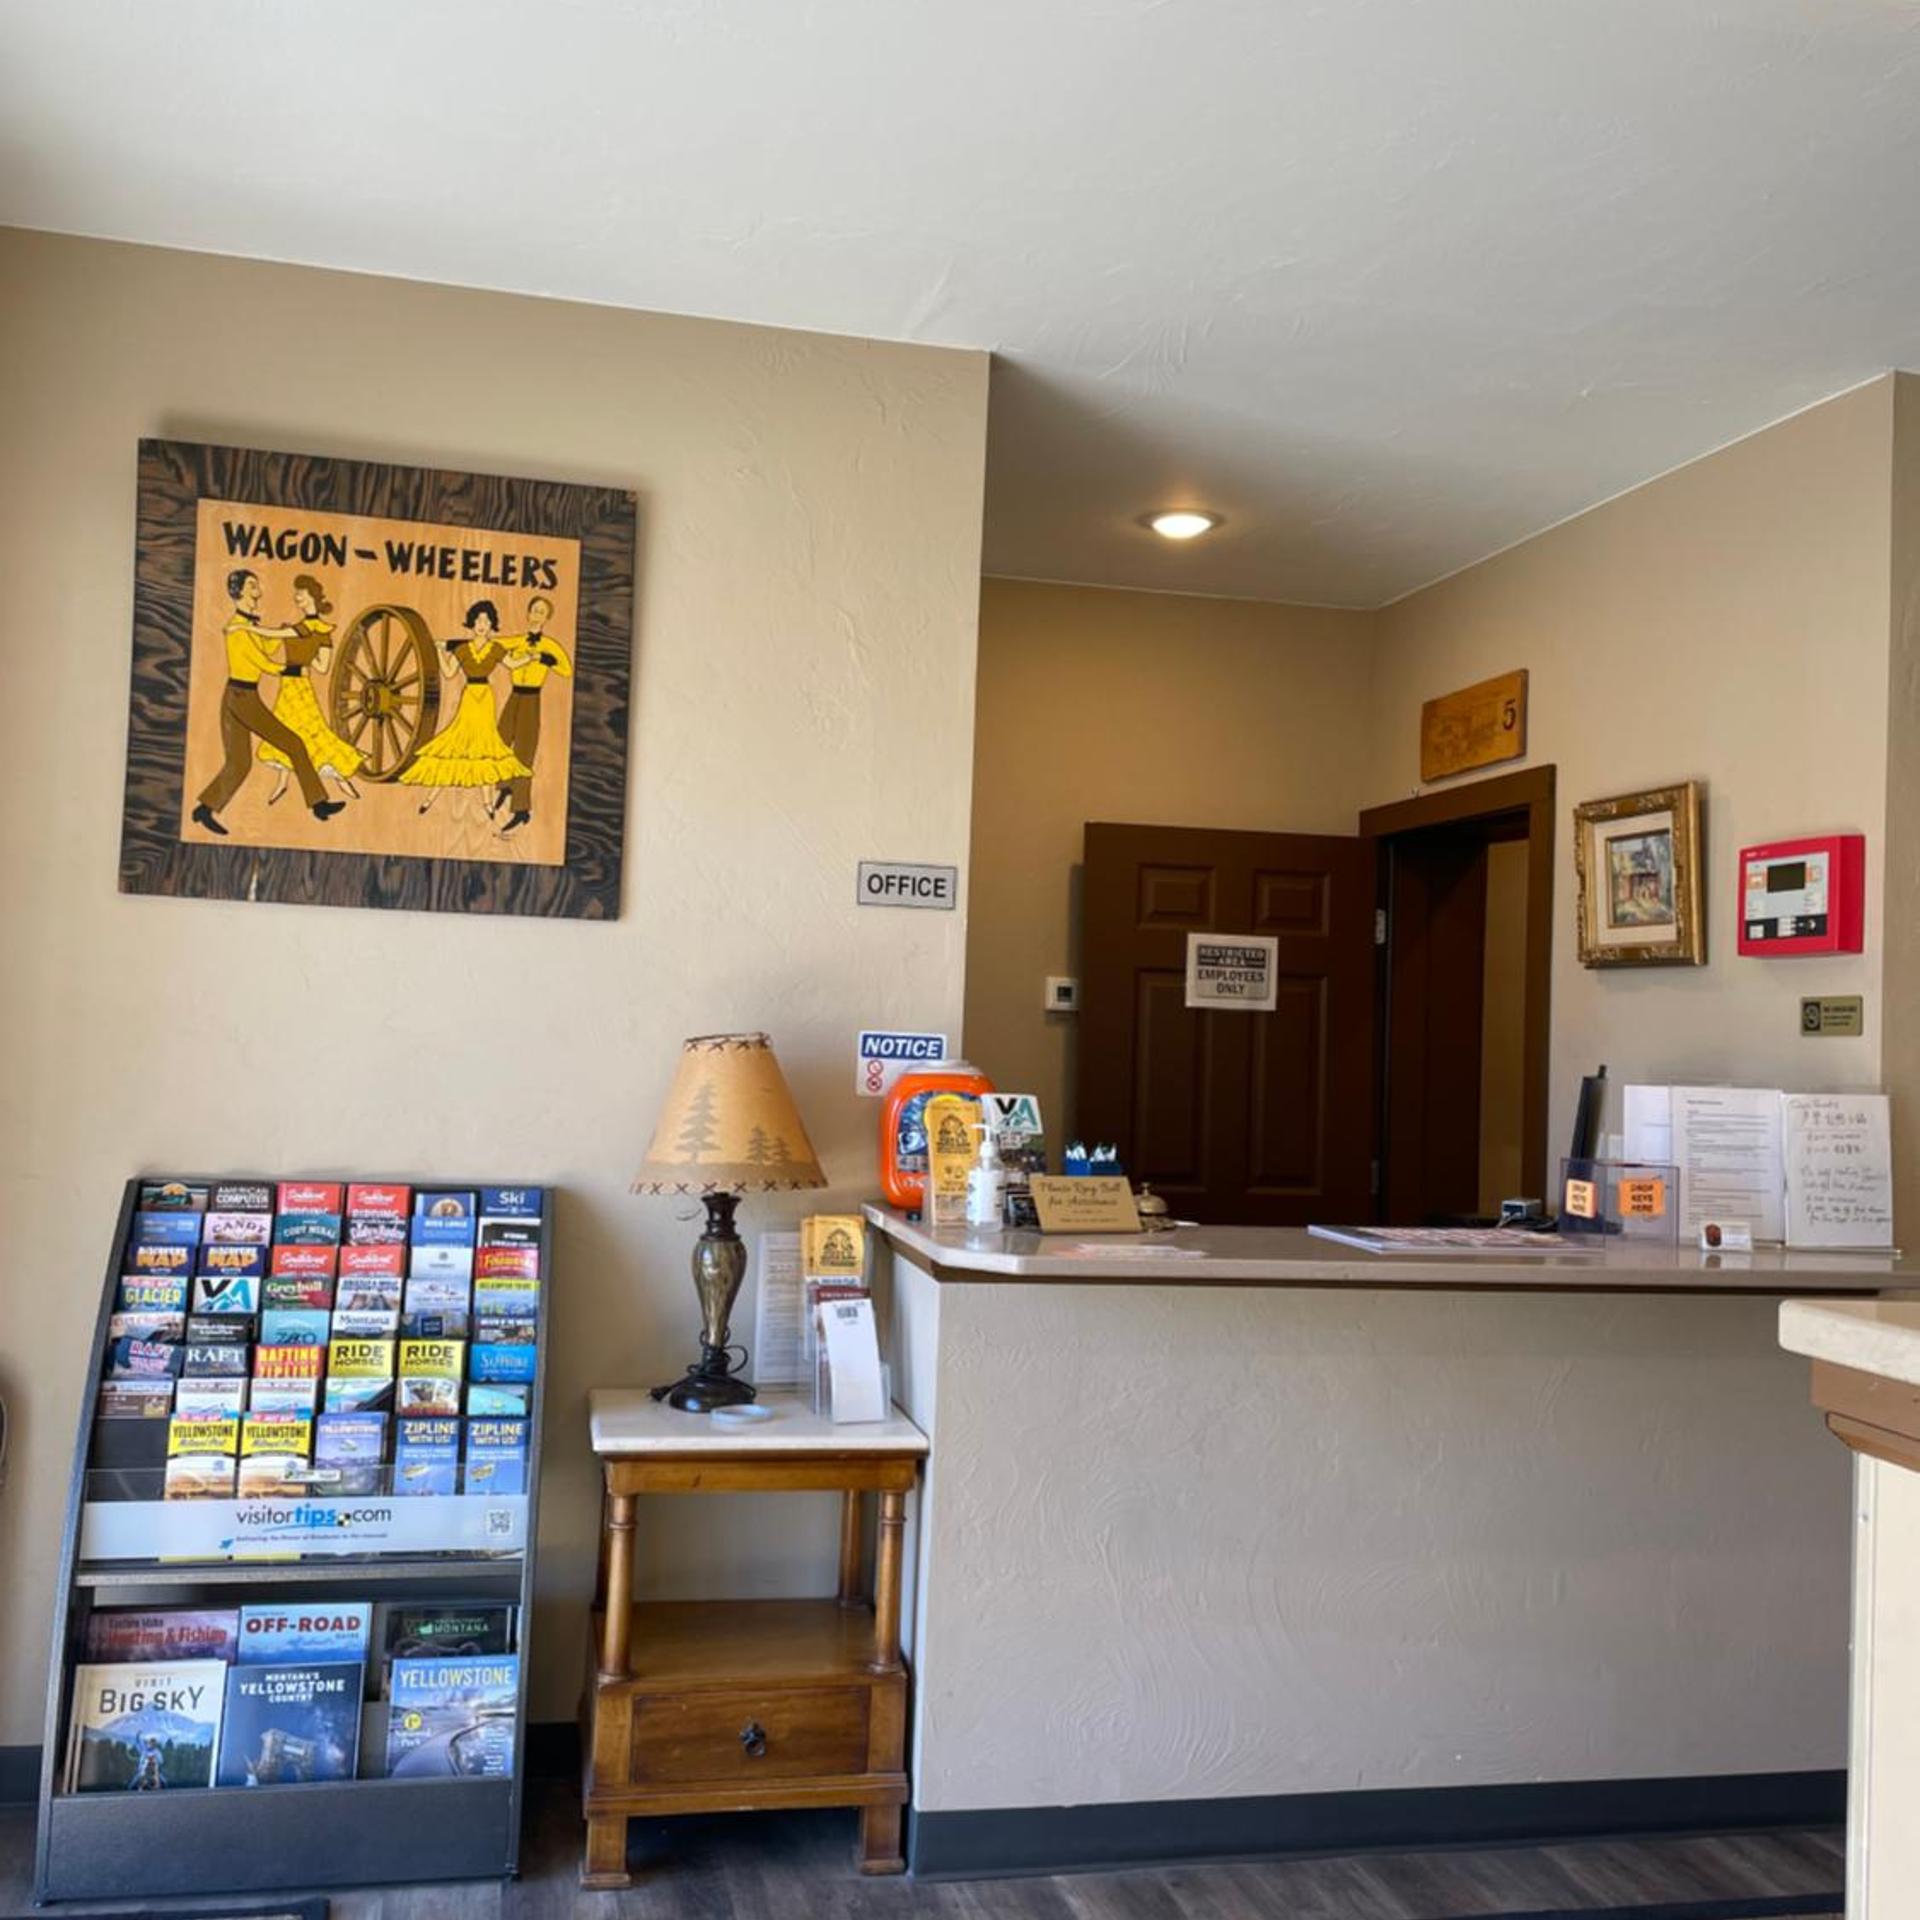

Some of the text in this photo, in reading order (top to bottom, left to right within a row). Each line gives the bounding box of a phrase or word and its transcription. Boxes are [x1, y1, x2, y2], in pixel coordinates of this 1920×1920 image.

[223, 521, 347, 568] WAGON
[385, 540, 558, 591] WHEELERS
[867, 873, 947, 898] OFFICE
[1199, 969, 1265, 983] EMPLOYEES
[1216, 983, 1246, 995] ONLY
[864, 1037, 941, 1058] NOTICE
[1630, 1184, 1654, 1193] DROP
[499, 1191, 525, 1205] Ski
[212, 1220, 268, 1234] CANDY
[125, 1287, 182, 1304] GLACIER
[187, 1347, 240, 1363] RAFT
[258, 1347, 319, 1361] RAFTING
[336, 1344, 385, 1358] RIDE
[406, 1344, 455, 1358] RIDE
[404, 1421, 457, 1435] ZIPLINE
[471, 1423, 524, 1437] ZIPLINE
[246, 1615, 362, 1634] OFF-ROAD
[434, 1622, 490, 1634] MONTANA
[265, 1671, 320, 1682] MONTANA'S
[400, 1664, 514, 1689] YELLOWSTONE
[240, 1679, 346, 1696] YELLOWSTONE
[100, 1684, 206, 1714] BIG SKY
[268, 1693, 313, 1703] COUNTRY
